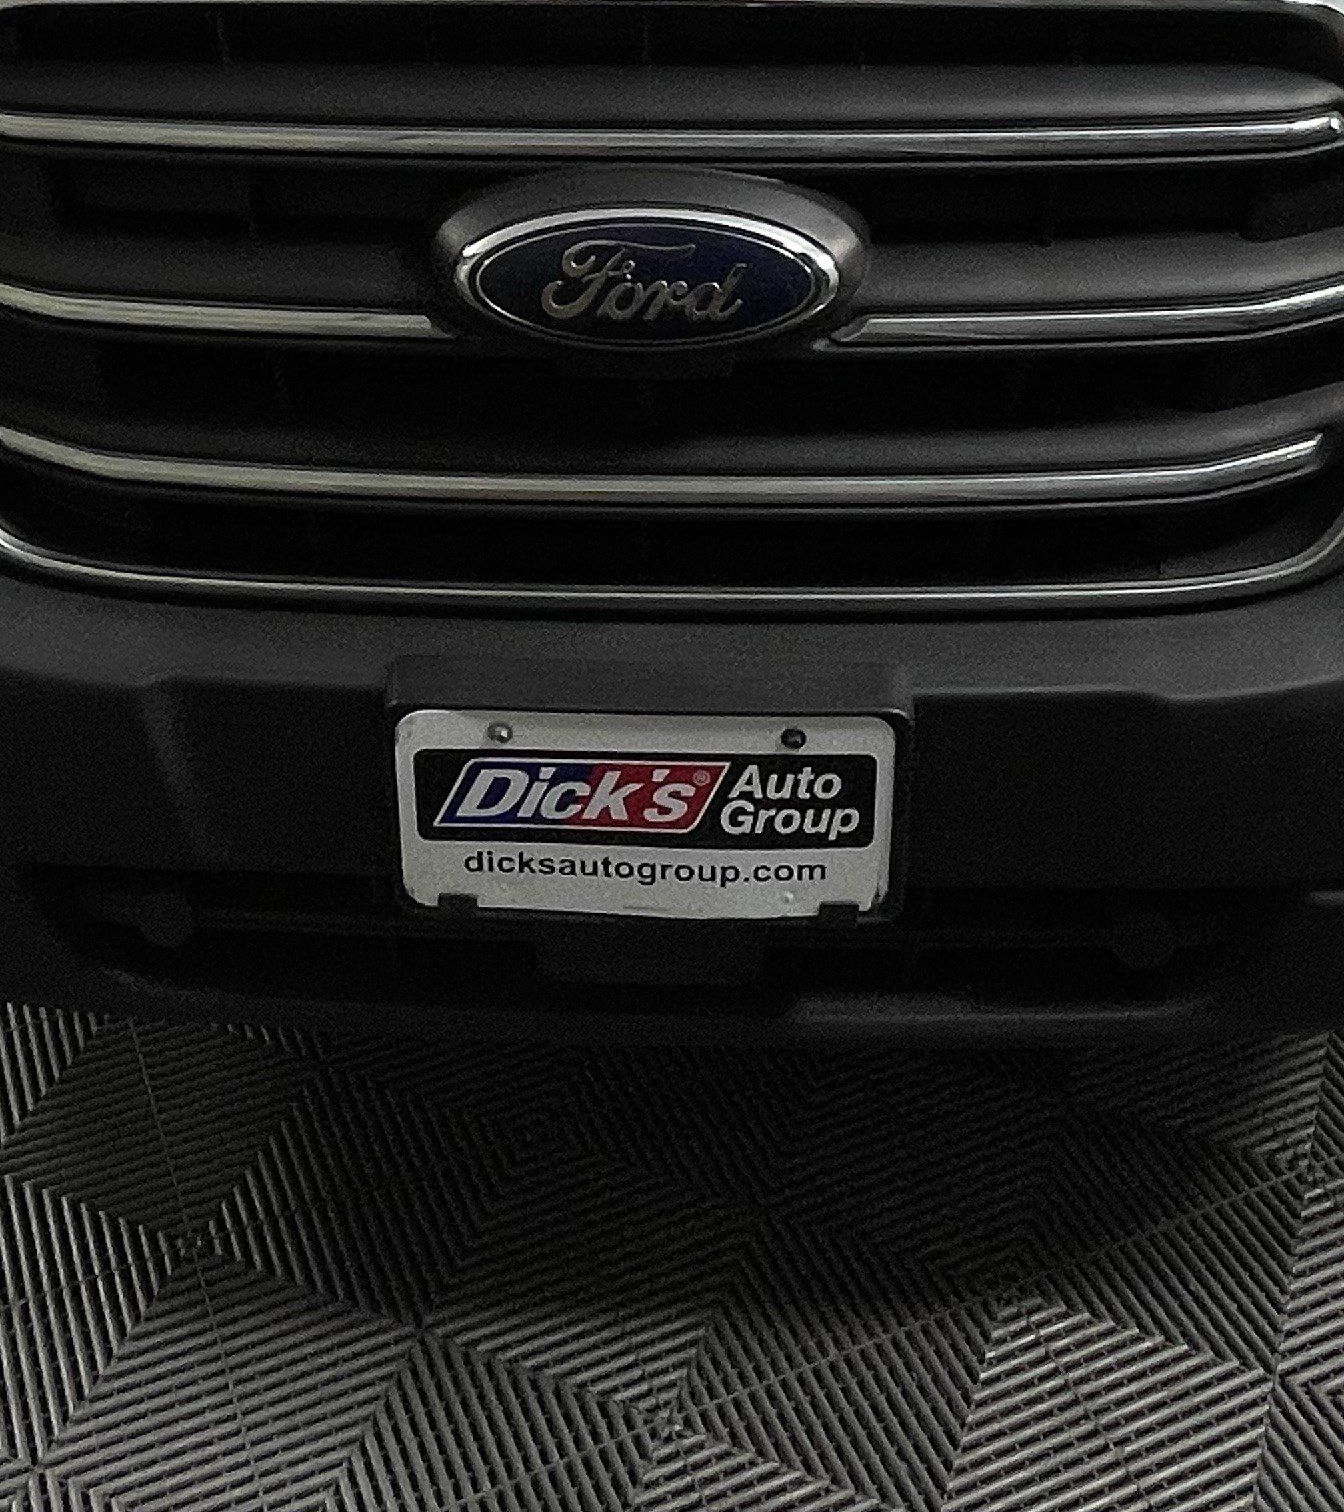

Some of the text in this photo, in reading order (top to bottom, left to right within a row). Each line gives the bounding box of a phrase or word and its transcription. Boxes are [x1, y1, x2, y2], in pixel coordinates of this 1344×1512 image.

[541, 239, 748, 322] Ford
[455, 766, 697, 822] Dick's
[728, 764, 842, 800] Auto
[720, 799, 860, 841] Group
[463, 850, 827, 887] dicksautogroup.com
